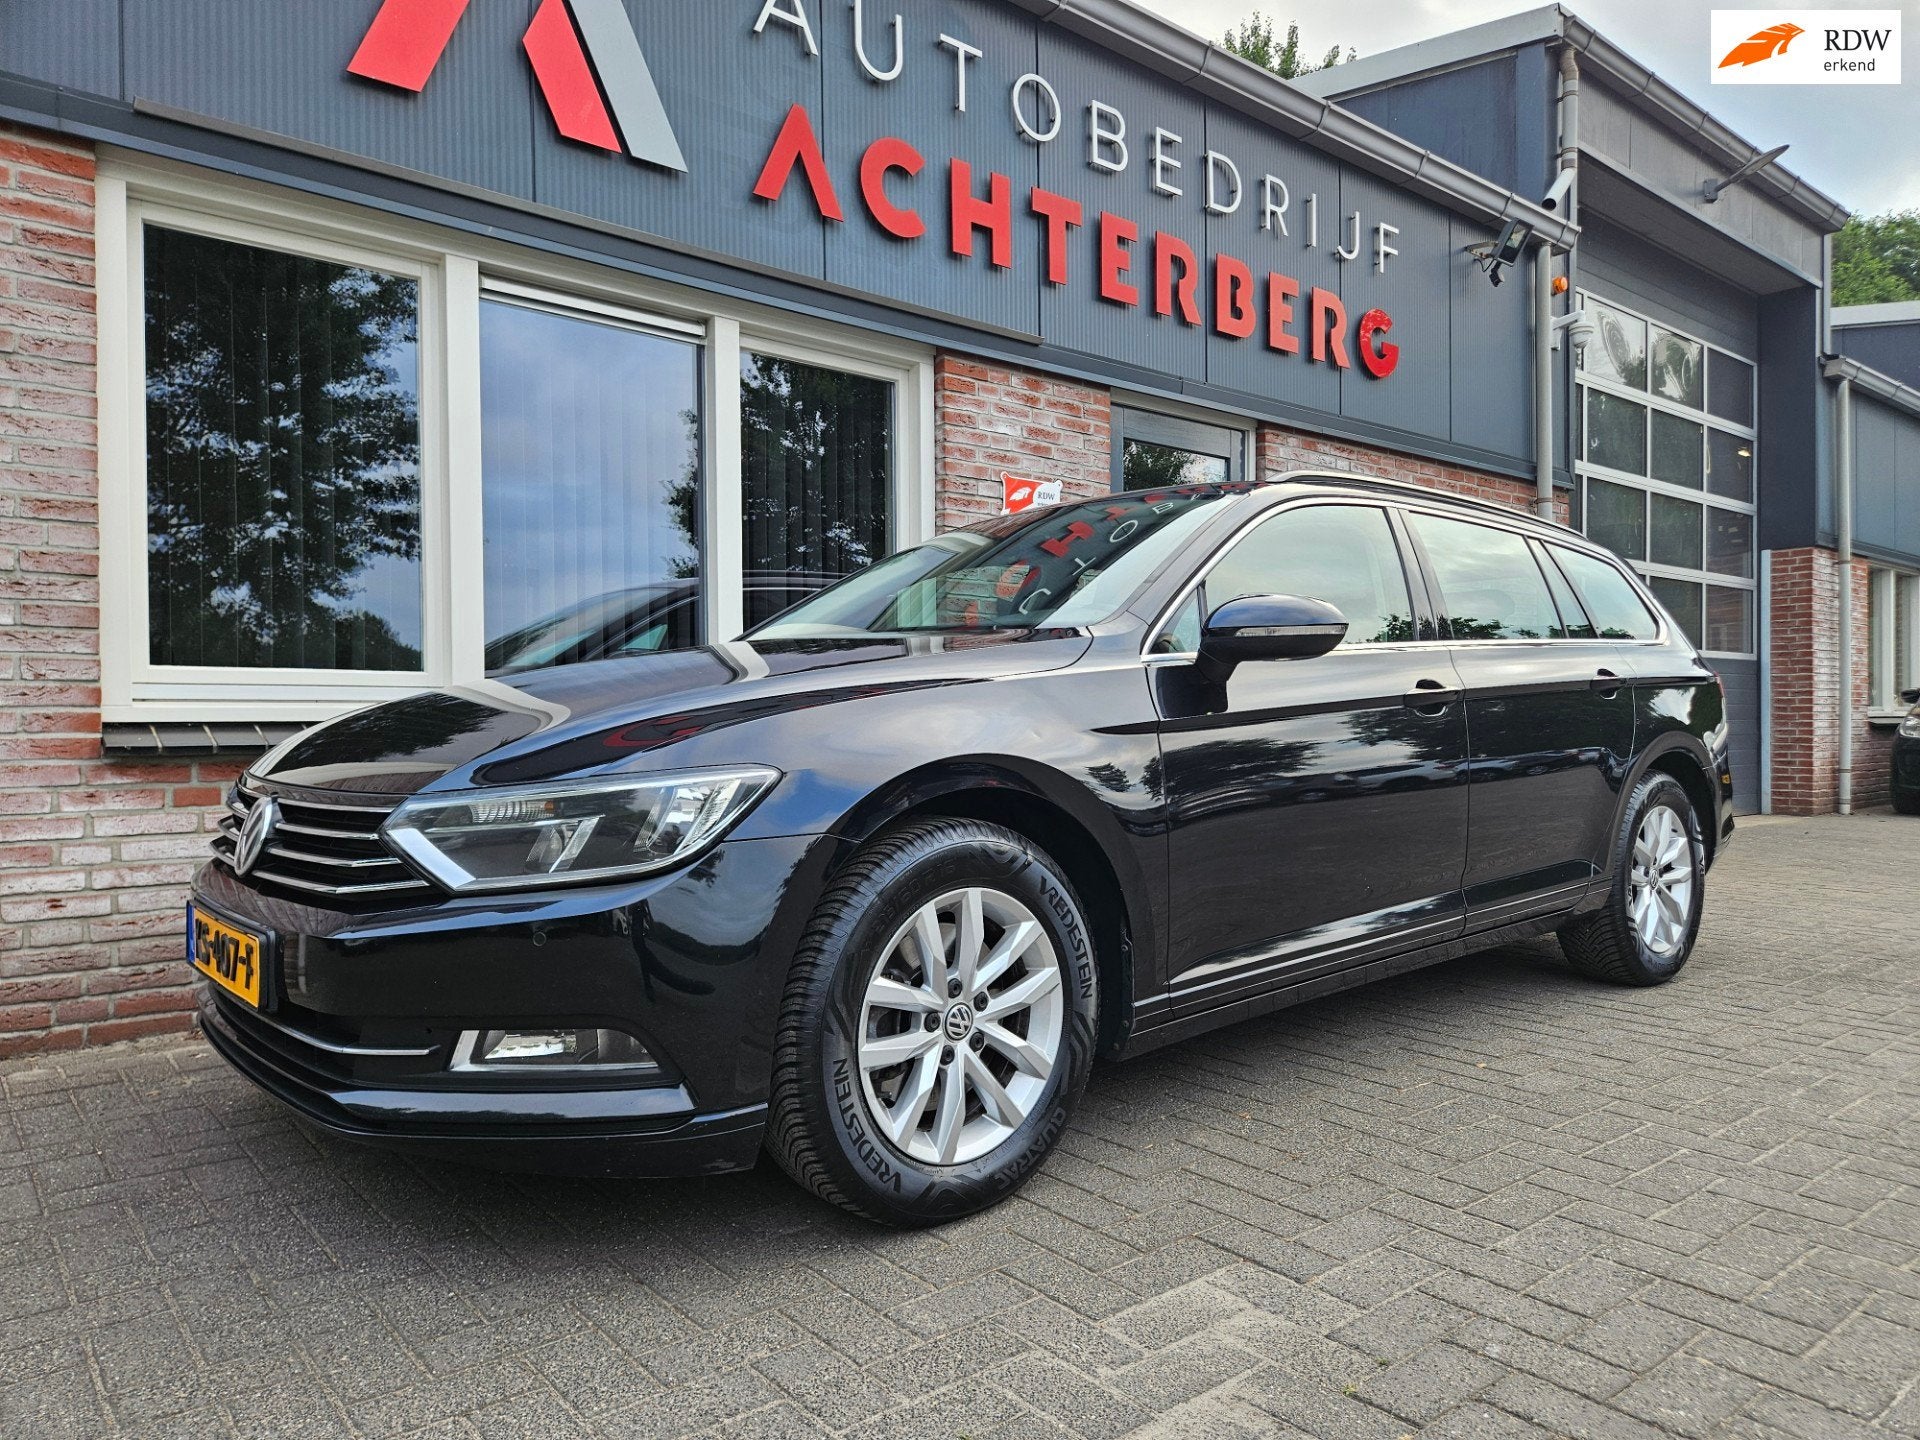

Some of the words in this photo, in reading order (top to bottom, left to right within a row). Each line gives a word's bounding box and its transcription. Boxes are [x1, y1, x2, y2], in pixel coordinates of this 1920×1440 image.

[752, 103, 1399, 379] ACHTERBERG
[1037, 491, 1056, 501] RDW
[1039, 875, 1093, 1000] VREDESTEIN
[832, 1057, 902, 1194] VREDESTEIN
[994, 1106, 1067, 1191] QUATRAC
